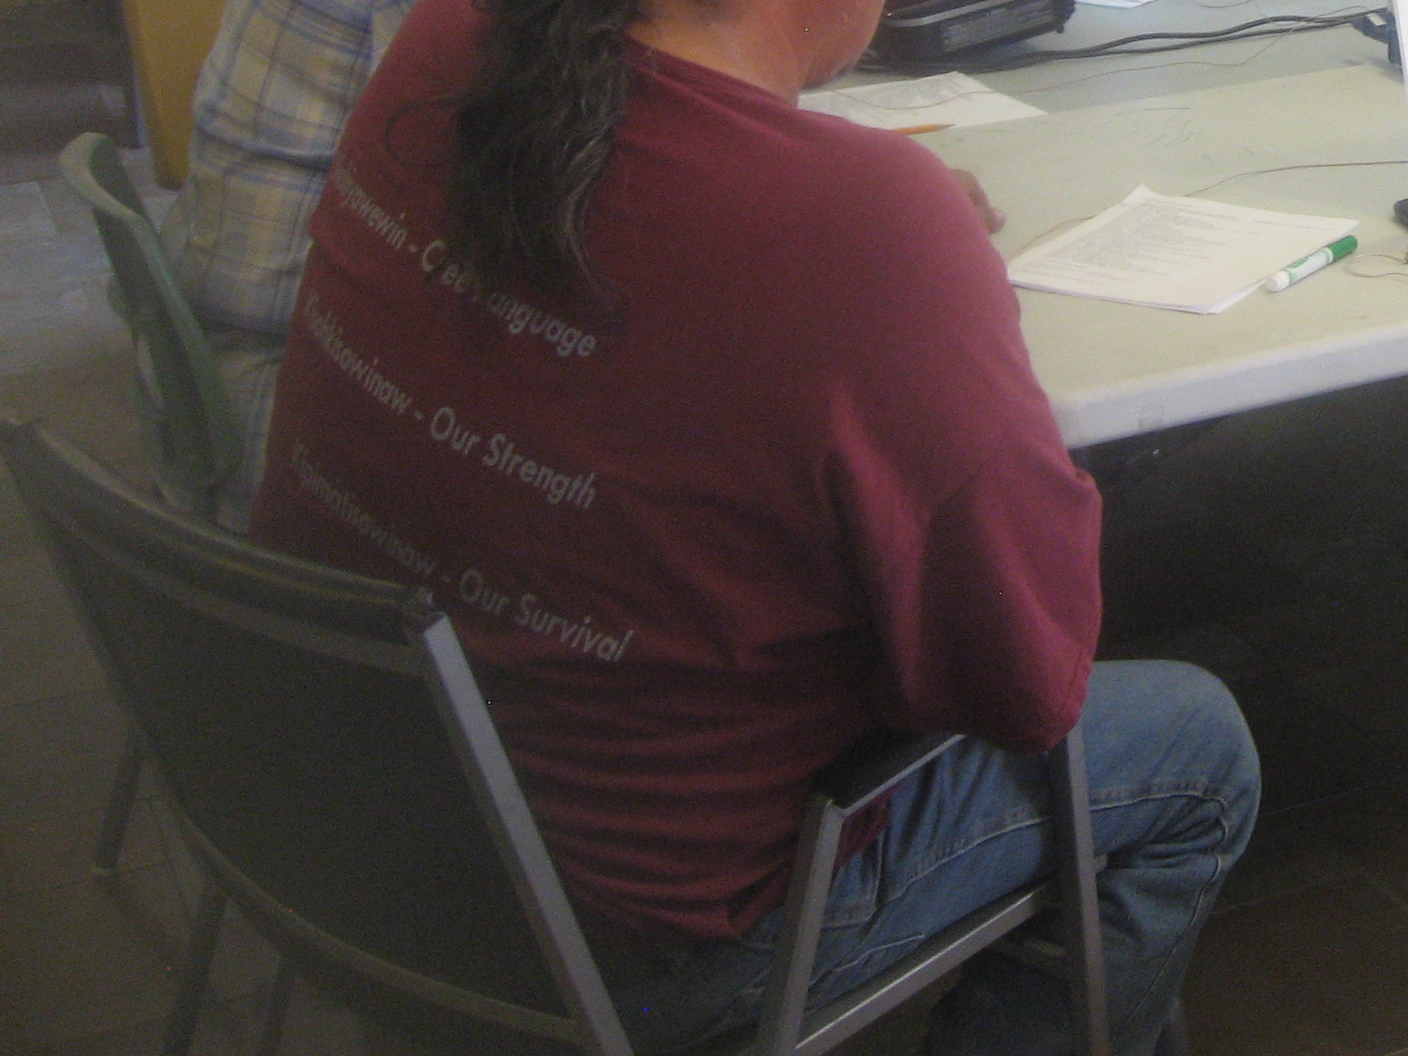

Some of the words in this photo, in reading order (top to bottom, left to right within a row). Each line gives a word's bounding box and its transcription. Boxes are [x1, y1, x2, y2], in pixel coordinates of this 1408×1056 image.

[421, 238, 474, 295] Cee
[473, 279, 600, 358] anguage
[430, 404, 482, 456] Our
[482, 432, 598, 511] Strength
[458, 567, 512, 617] Our
[514, 592, 635, 664] Survival
